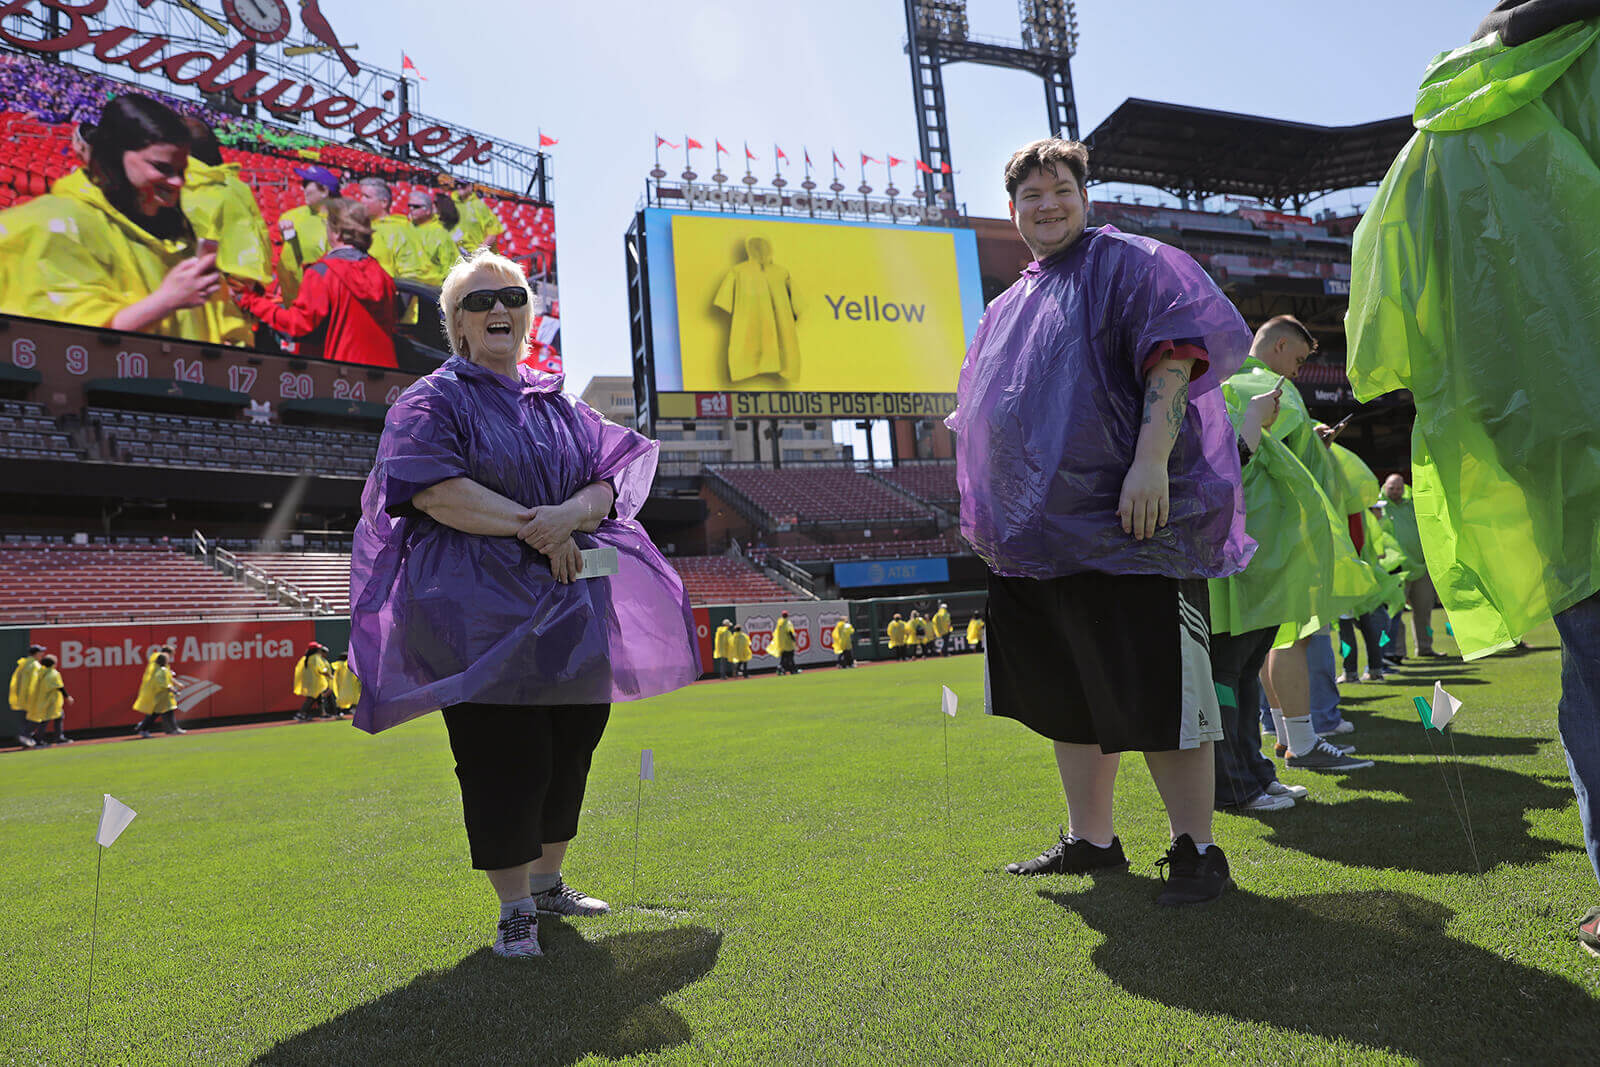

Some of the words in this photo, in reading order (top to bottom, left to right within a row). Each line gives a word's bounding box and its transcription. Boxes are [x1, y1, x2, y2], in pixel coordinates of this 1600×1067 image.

[681, 183, 783, 209] WORLD
[789, 194, 943, 221] CHAMPIONS
[824, 294, 926, 323] Yellow
[12, 338, 37, 369] 6
[66, 345, 89, 375] 9
[116, 351, 149, 379] 10
[174, 358, 205, 385] 14
[228, 365, 258, 393] 17
[279, 371, 314, 400] 20
[333, 379, 366, 402] 24
[737, 392, 764, 414] ST.
[768, 392, 823, 415] LOUIS
[831, 393, 955, 415] POST-DISPATC
[888, 566, 917, 578] AT&T
[60, 637, 142, 669] Bank
[180, 633, 294, 662] America
